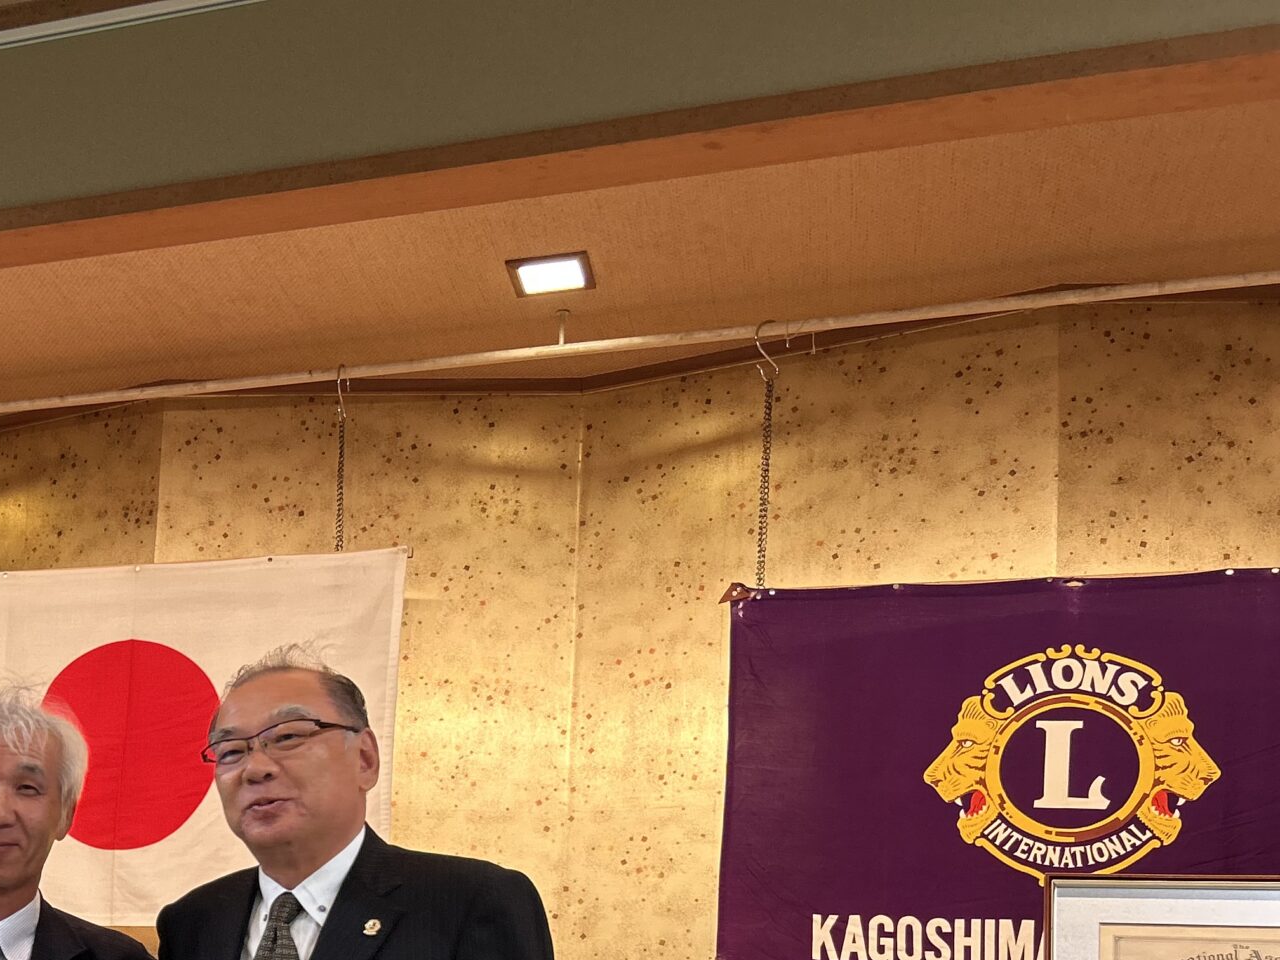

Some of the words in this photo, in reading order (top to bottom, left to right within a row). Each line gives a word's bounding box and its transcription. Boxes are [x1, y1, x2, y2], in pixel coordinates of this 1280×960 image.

[997, 658, 1148, 707] LIONS
[1033, 720, 1111, 810] L
[982, 818, 1154, 869] INTERNATIONAL
